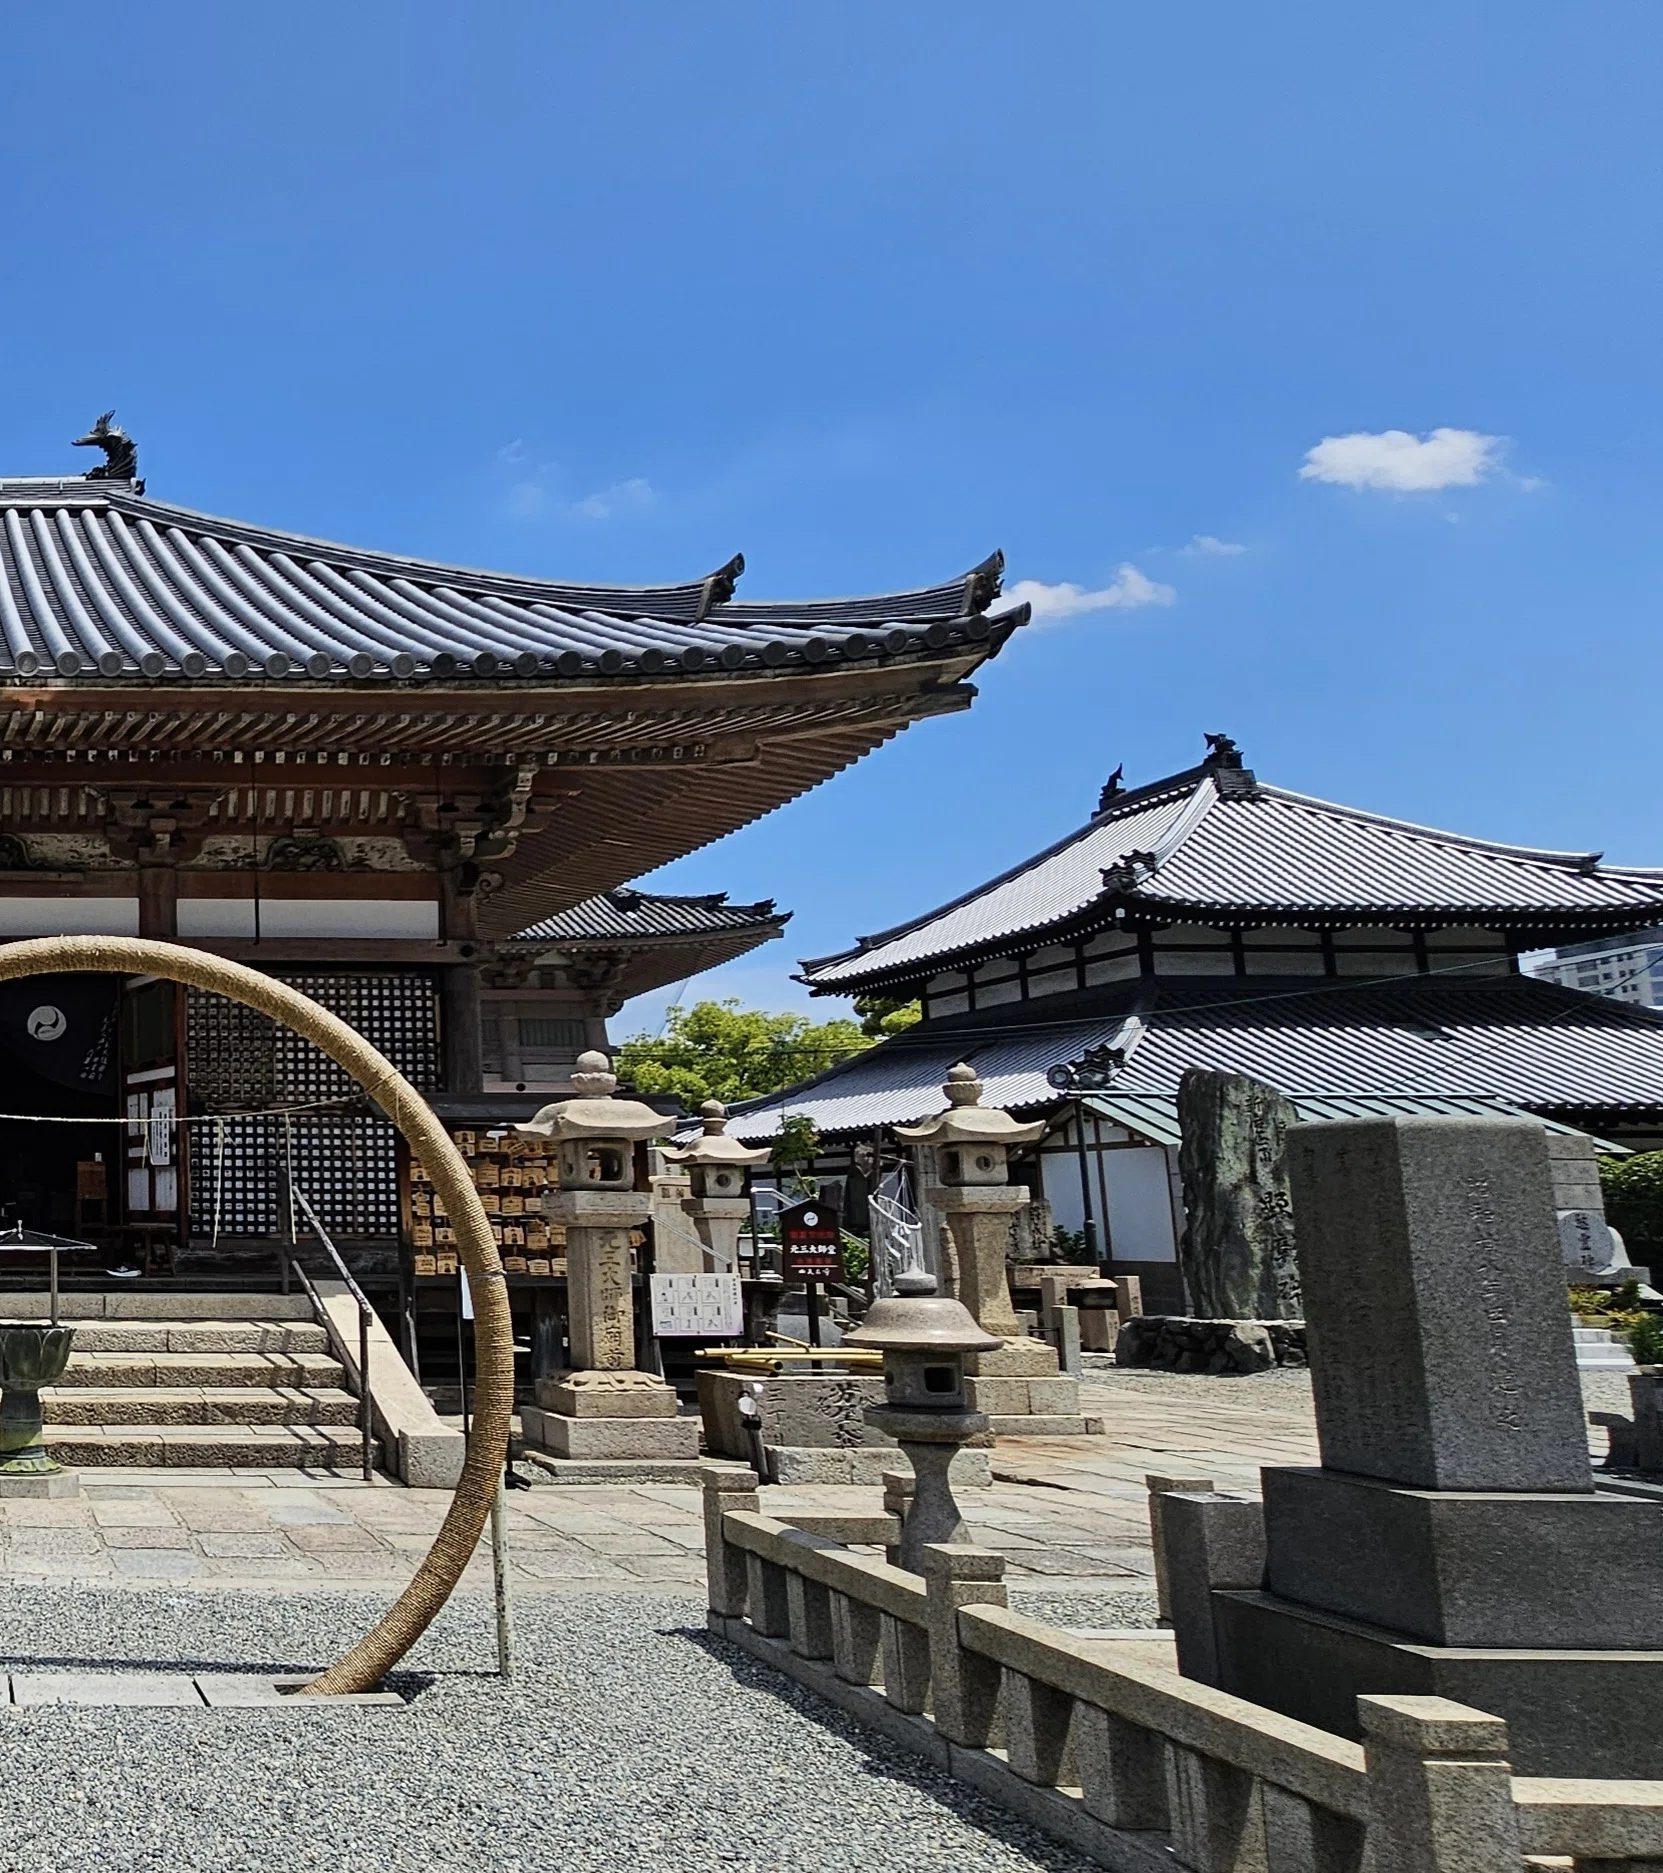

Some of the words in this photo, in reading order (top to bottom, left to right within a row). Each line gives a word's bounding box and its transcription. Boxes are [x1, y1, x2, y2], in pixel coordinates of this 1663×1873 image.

[790, 1244, 837, 1255] 元三大師堂
